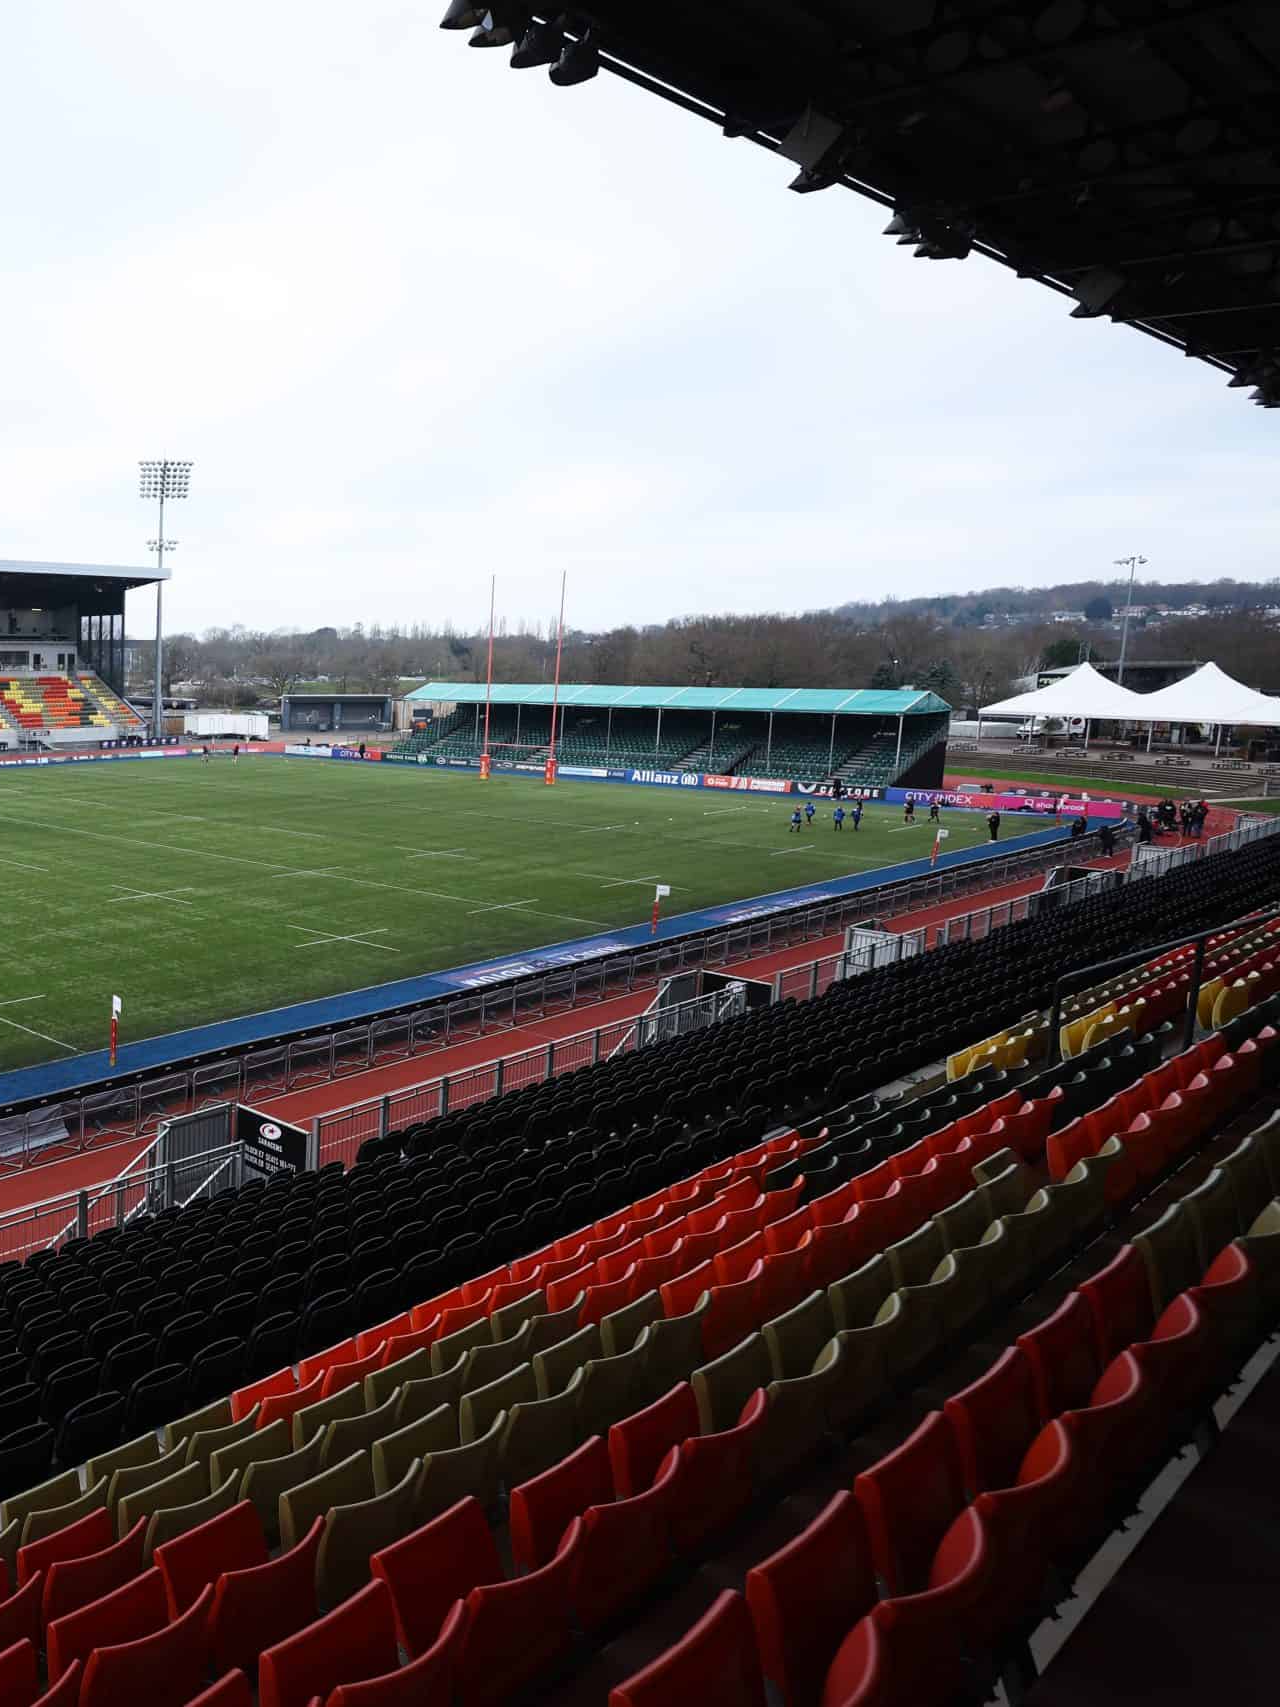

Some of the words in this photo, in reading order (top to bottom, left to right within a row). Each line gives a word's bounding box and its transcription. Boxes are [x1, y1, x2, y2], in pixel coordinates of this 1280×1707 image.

[631, 769, 679, 785] Allianz
[905, 791, 934, 803] CITY
[935, 793, 973, 806] INDEX
